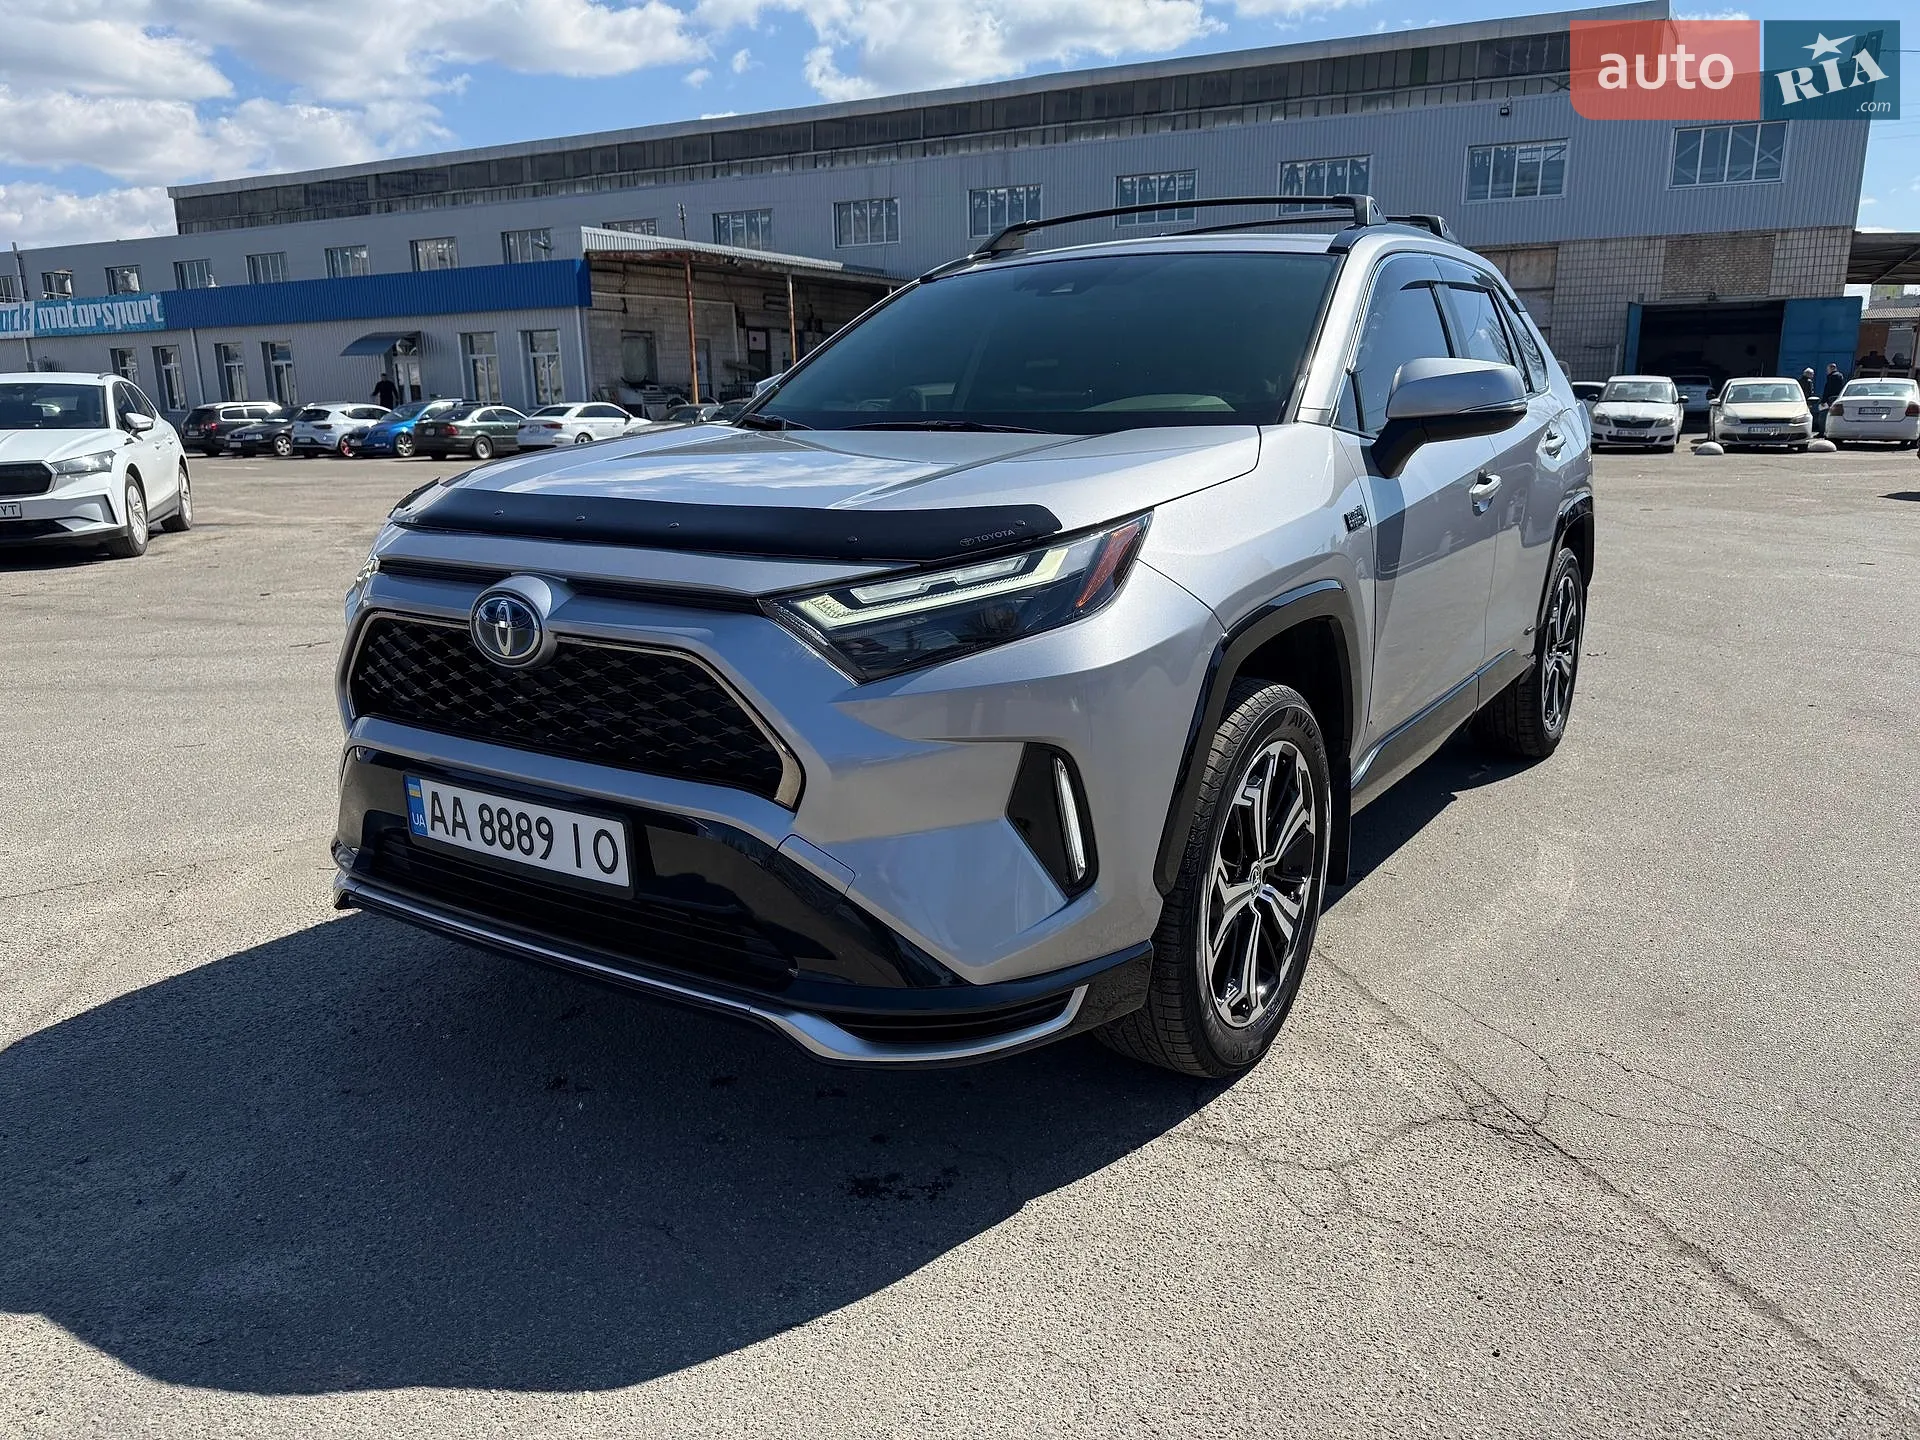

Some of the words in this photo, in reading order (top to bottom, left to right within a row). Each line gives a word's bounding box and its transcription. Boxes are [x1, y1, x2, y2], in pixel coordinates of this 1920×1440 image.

[37, 295, 164, 330] motorsport
[975, 529, 1015, 543] TOYOTA
[412, 811, 426, 828] UA
[430, 790, 472, 842] AA
[478, 803, 554, 860] 8889
